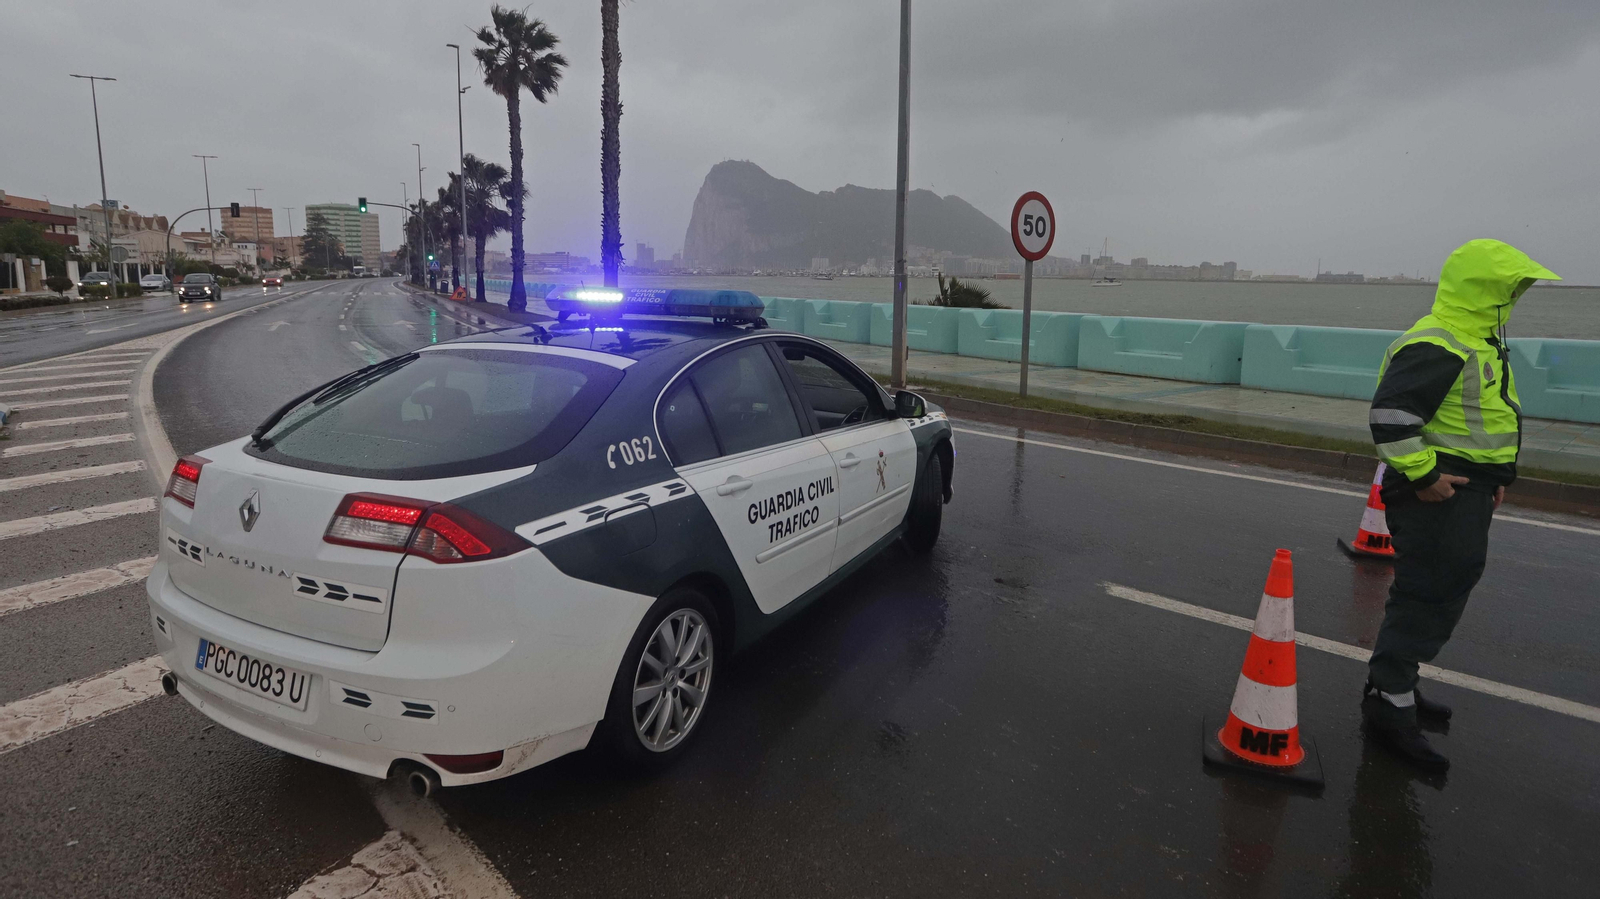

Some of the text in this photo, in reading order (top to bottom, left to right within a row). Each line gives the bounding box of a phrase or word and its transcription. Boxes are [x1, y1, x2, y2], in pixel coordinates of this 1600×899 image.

[1023, 214, 1047, 238] 50
[619, 435, 657, 465] 062
[748, 476, 834, 524] GUARDIA CIVIL
[768, 506, 819, 543] TRAFICO
[206, 546, 291, 579] LAGUNA
[1240, 726, 1289, 757] MF
